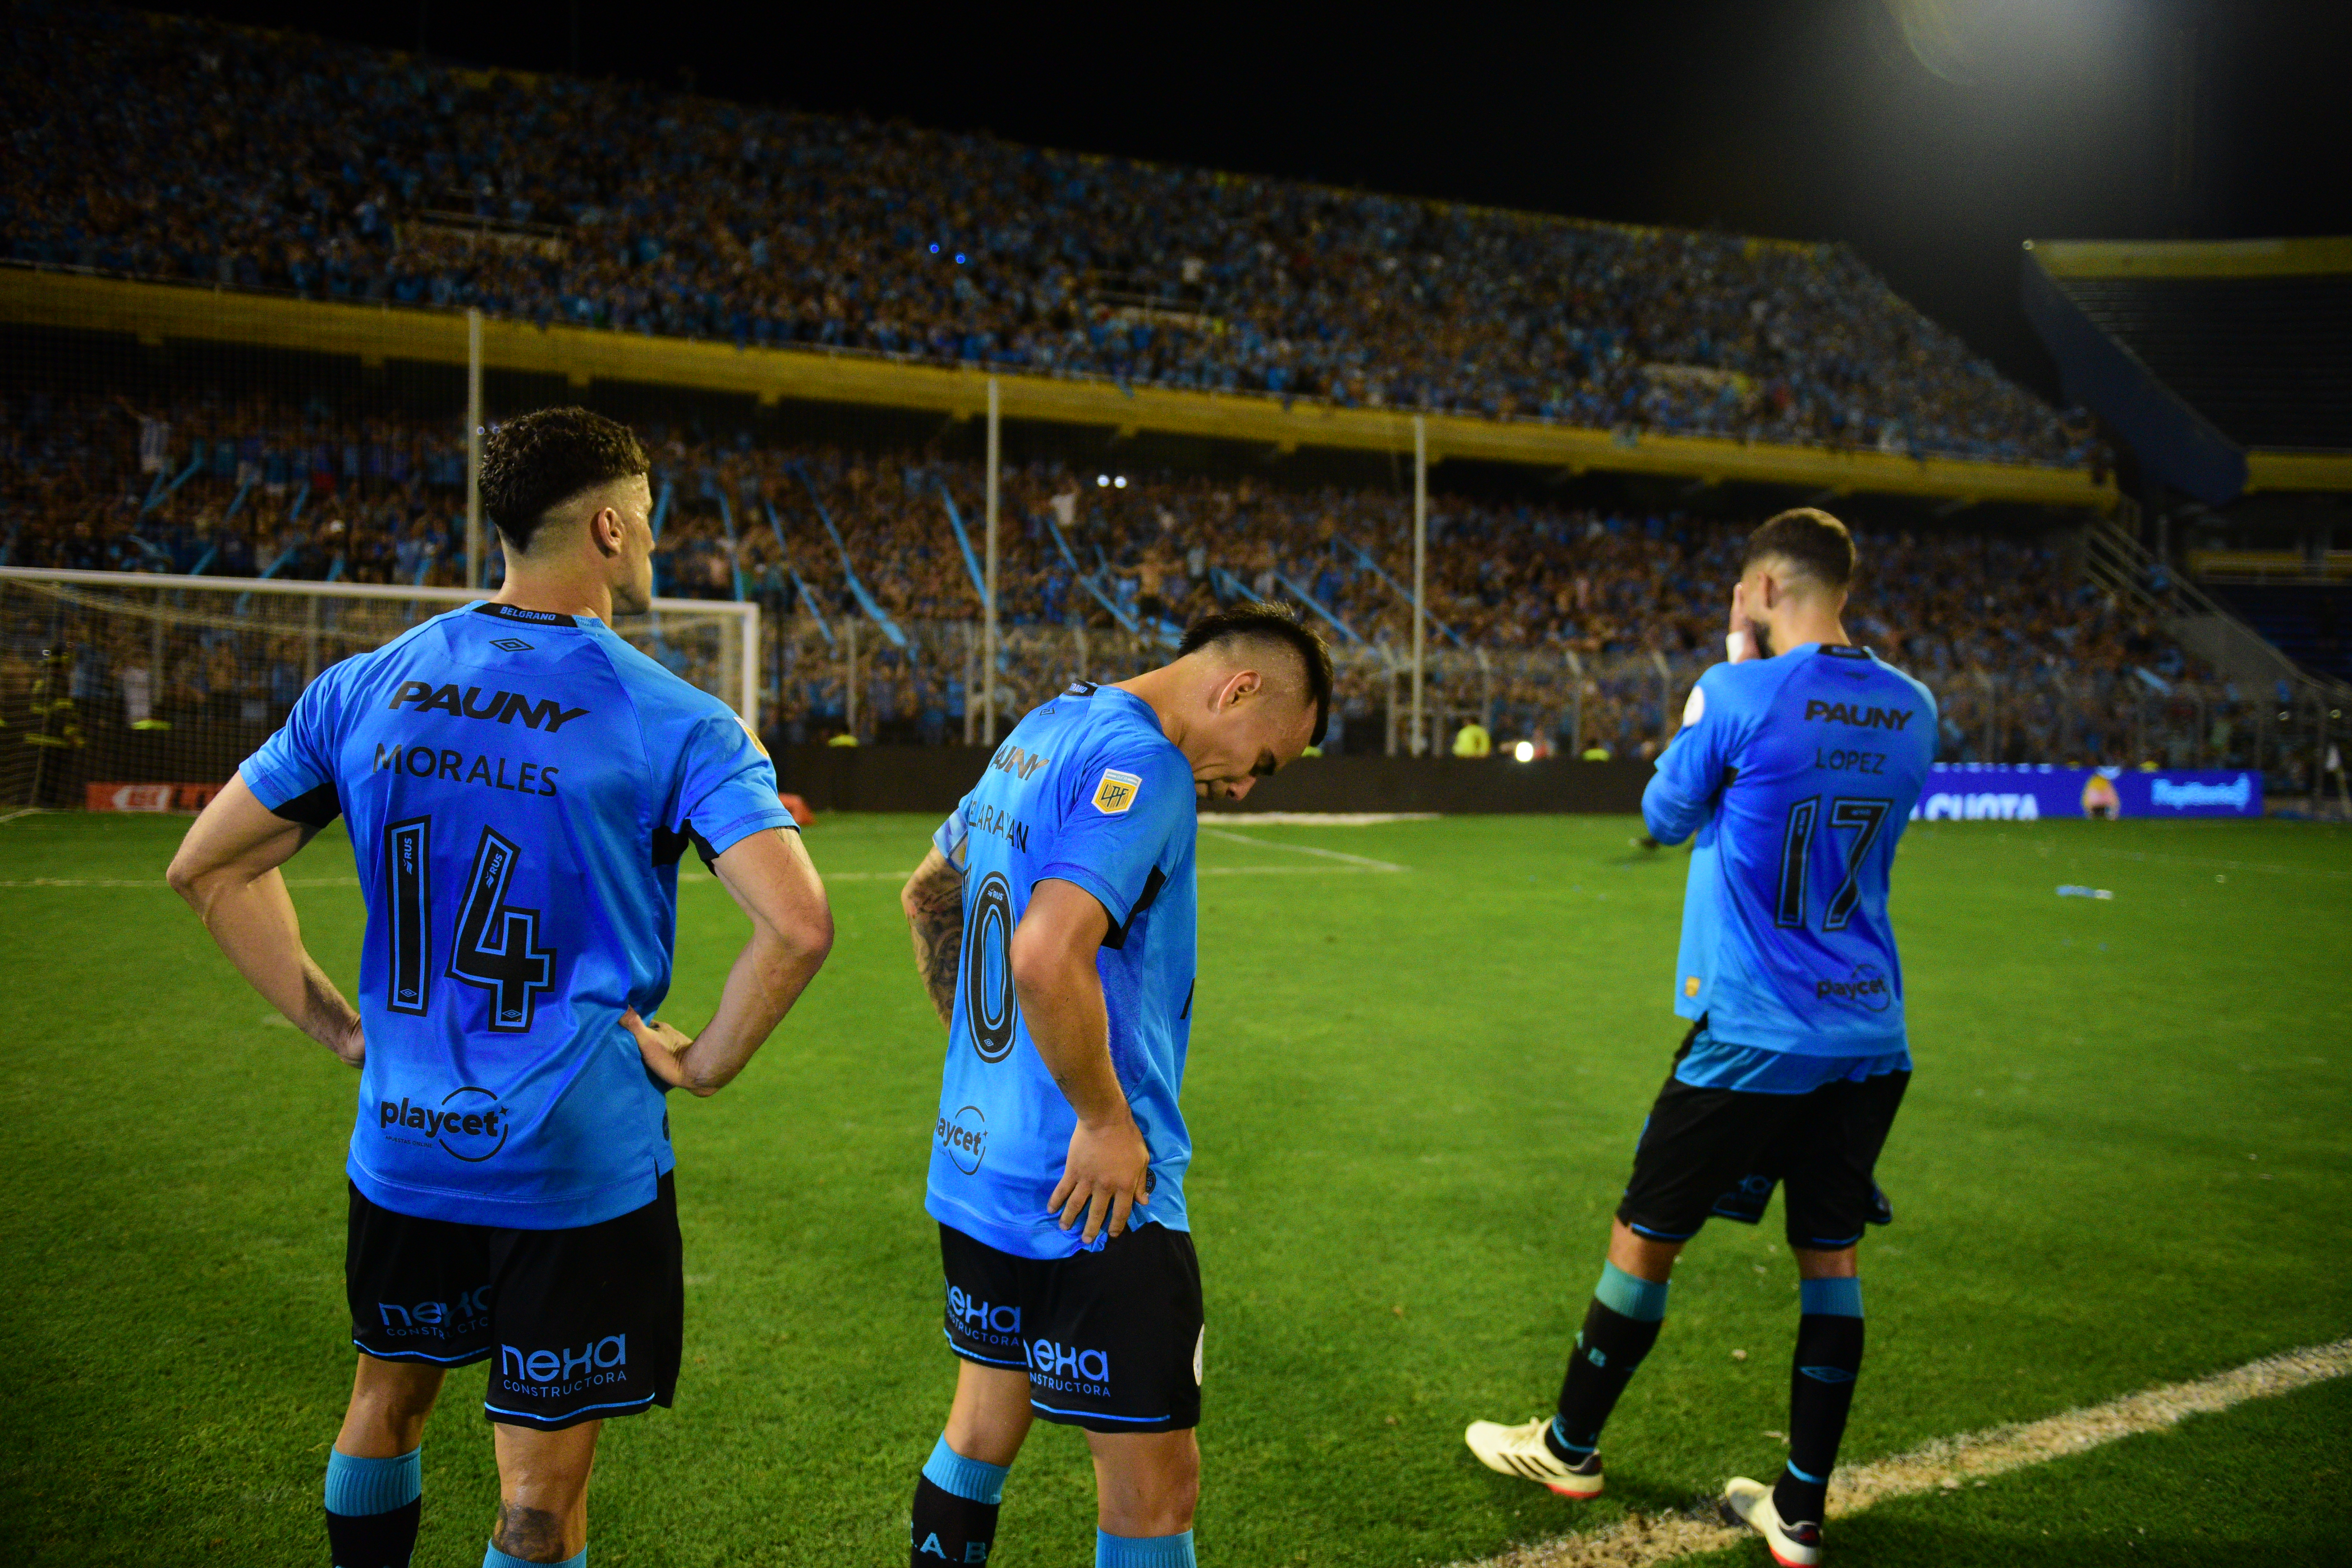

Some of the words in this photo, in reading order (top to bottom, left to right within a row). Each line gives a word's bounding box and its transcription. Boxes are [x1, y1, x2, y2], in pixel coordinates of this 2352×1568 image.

[500, 606, 556, 620] BELGRANO
[389, 680, 591, 733] PAUNY
[1804, 699, 1914, 731] PAUNY
[373, 743, 559, 796] MORALES
[990, 744, 1050, 781] AUNY
[1816, 747, 1886, 775] LOPEZ
[489, 853, 503, 875] RUS
[1775, 794, 1895, 932] 17
[993, 890, 1003, 901] RUS
[384, 814, 557, 1033] 14
[381, 1097, 499, 1138] playcet
[385, 1135, 411, 1145] APUESTAS
[412, 1140, 433, 1149] ONLINE
[501, 1333, 626, 1382] nexa
[503, 1369, 627, 1398] CONSTRUCTORA
[1029, 1372, 1111, 1398] NSTRUCTORA
